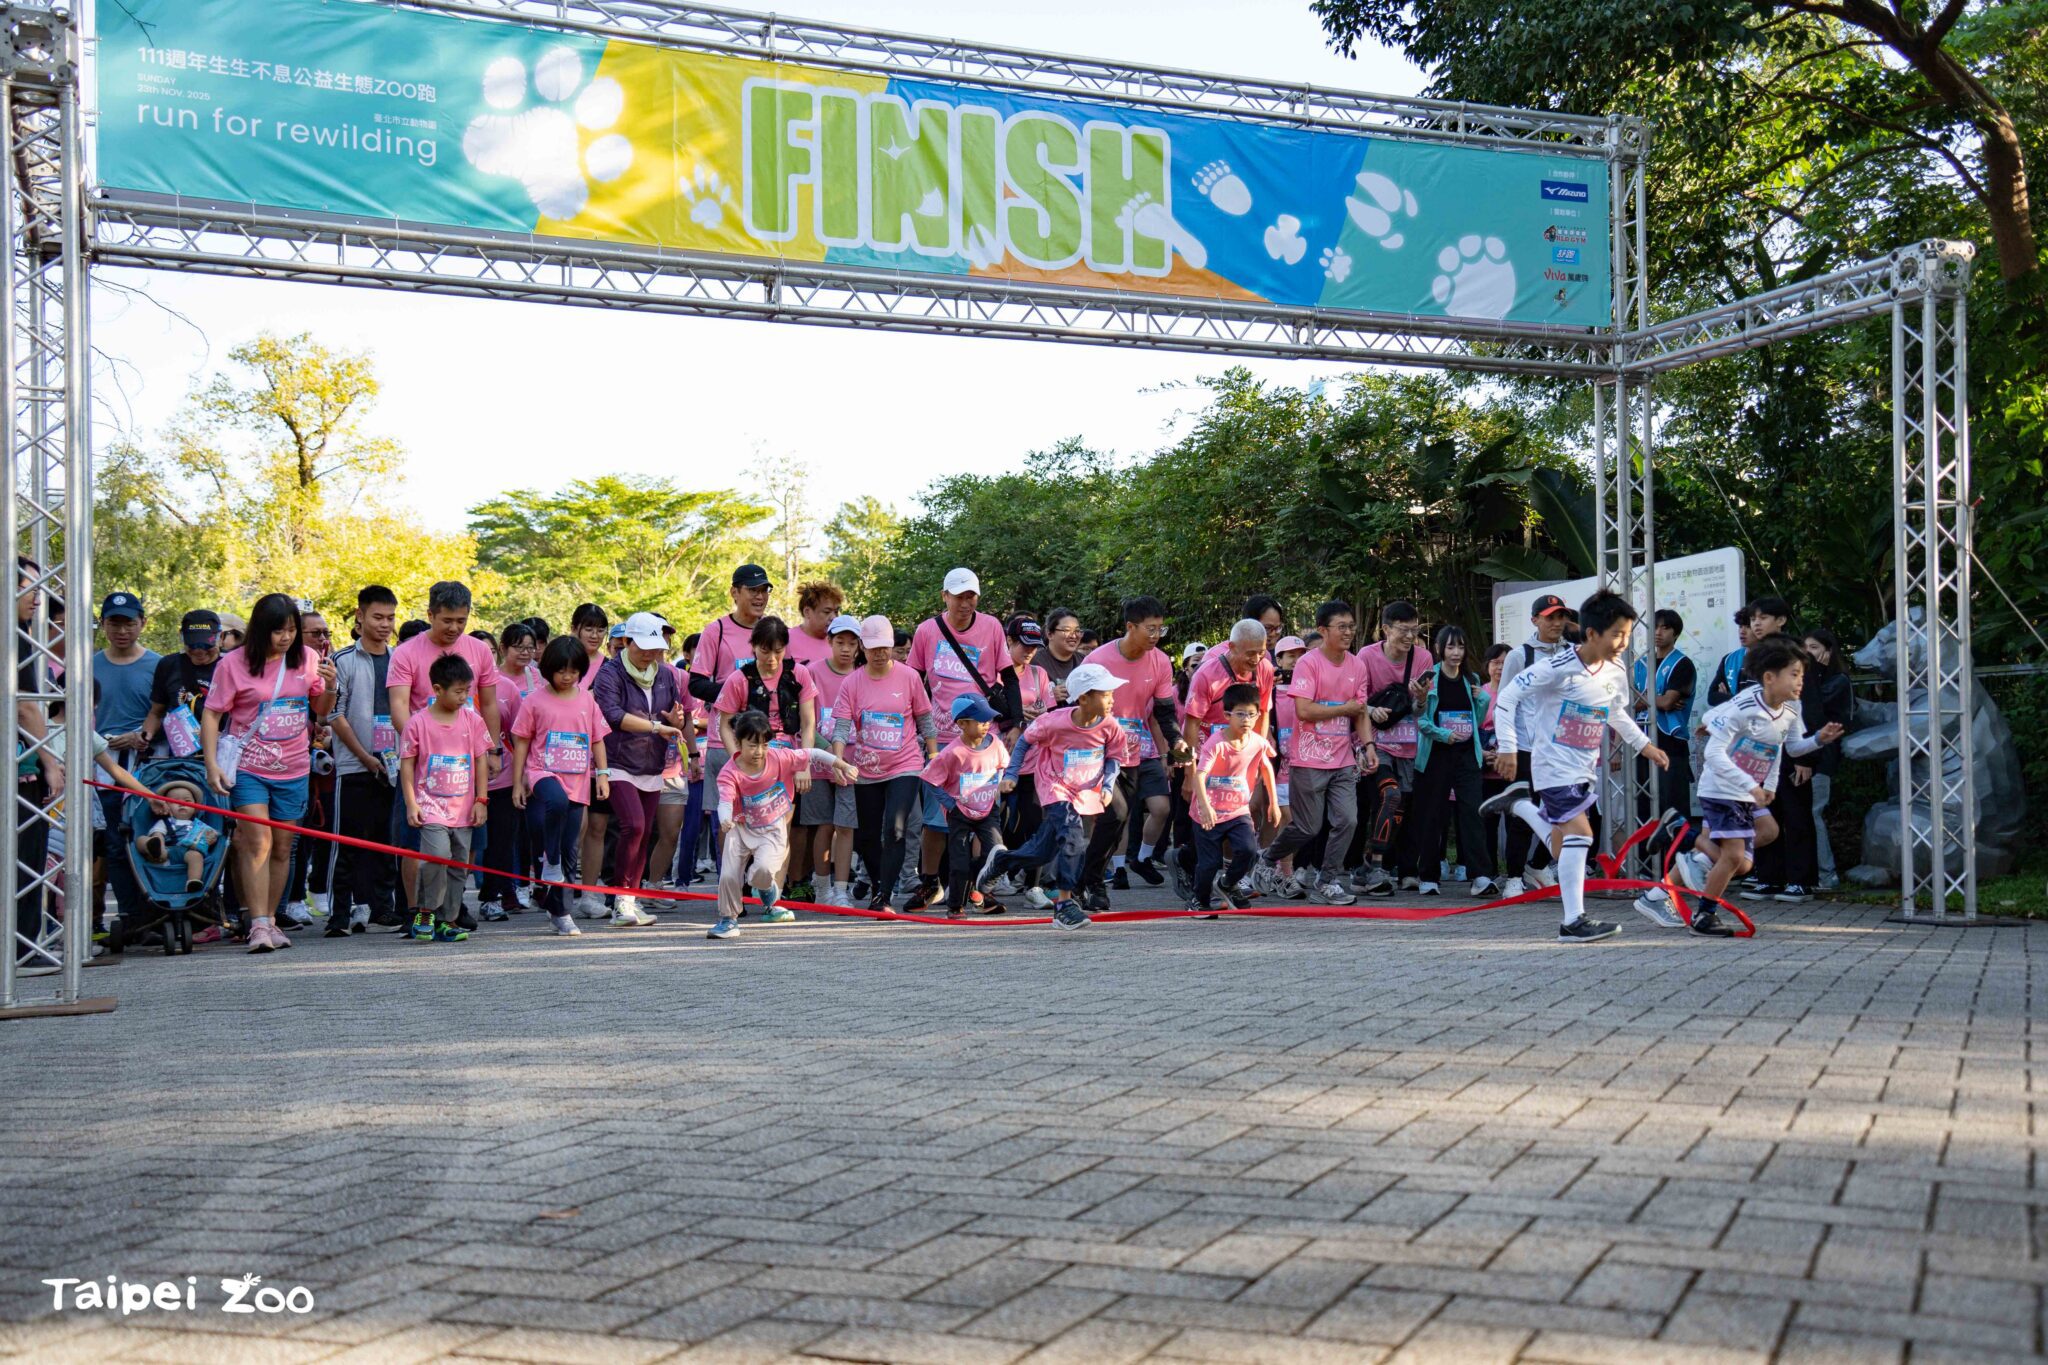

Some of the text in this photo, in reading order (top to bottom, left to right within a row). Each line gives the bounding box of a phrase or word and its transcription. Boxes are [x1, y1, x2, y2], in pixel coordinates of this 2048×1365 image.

[137, 73, 176, 85] SUNDAY
[187, 91, 211, 101] 2025
[138, 103, 437, 167] run for rewilding
[742, 77, 1172, 278] FINISH
[276, 712, 306, 727] 2034
[871, 730, 902, 743] V087
[1577, 723, 1604, 737] 1098
[169, 725, 192, 756] V093
[561, 749, 587, 762] 2035
